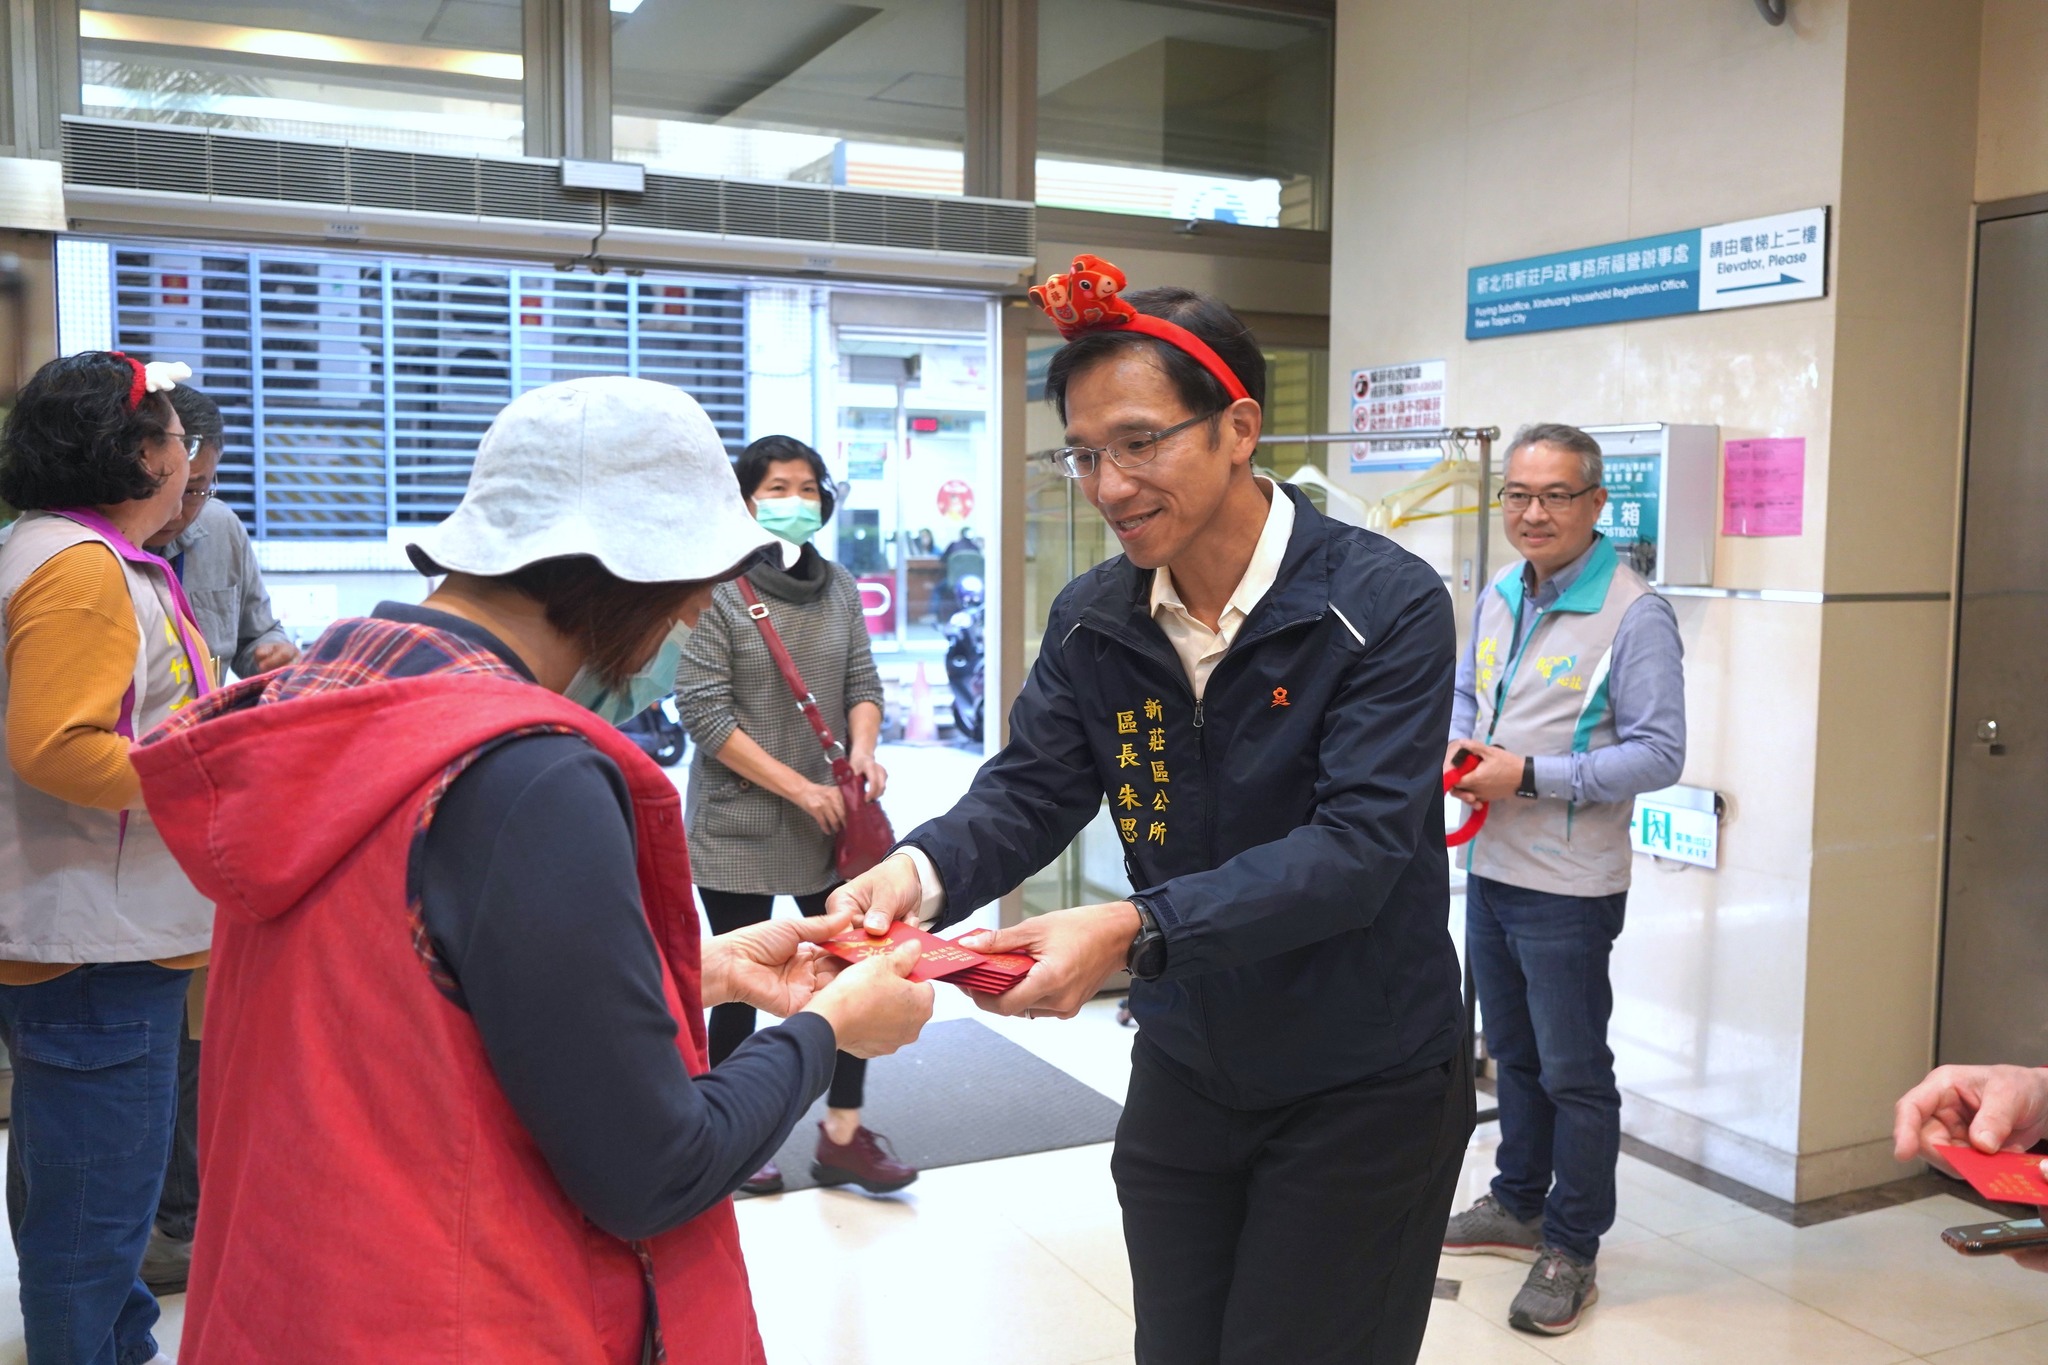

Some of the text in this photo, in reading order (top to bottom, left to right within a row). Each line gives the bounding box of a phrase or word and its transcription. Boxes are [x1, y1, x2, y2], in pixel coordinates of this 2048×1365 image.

[1710, 226, 1817, 259] 請由電梯上二樓
[1717, 252, 1807, 275] Elevator, Please
[1612, 283, 1660, 299] Registration
[1660, 279, 1689, 291] Office,
[1143, 697, 1171, 846] 新莊區公所
[1677, 844, 1707, 858] EXIT
